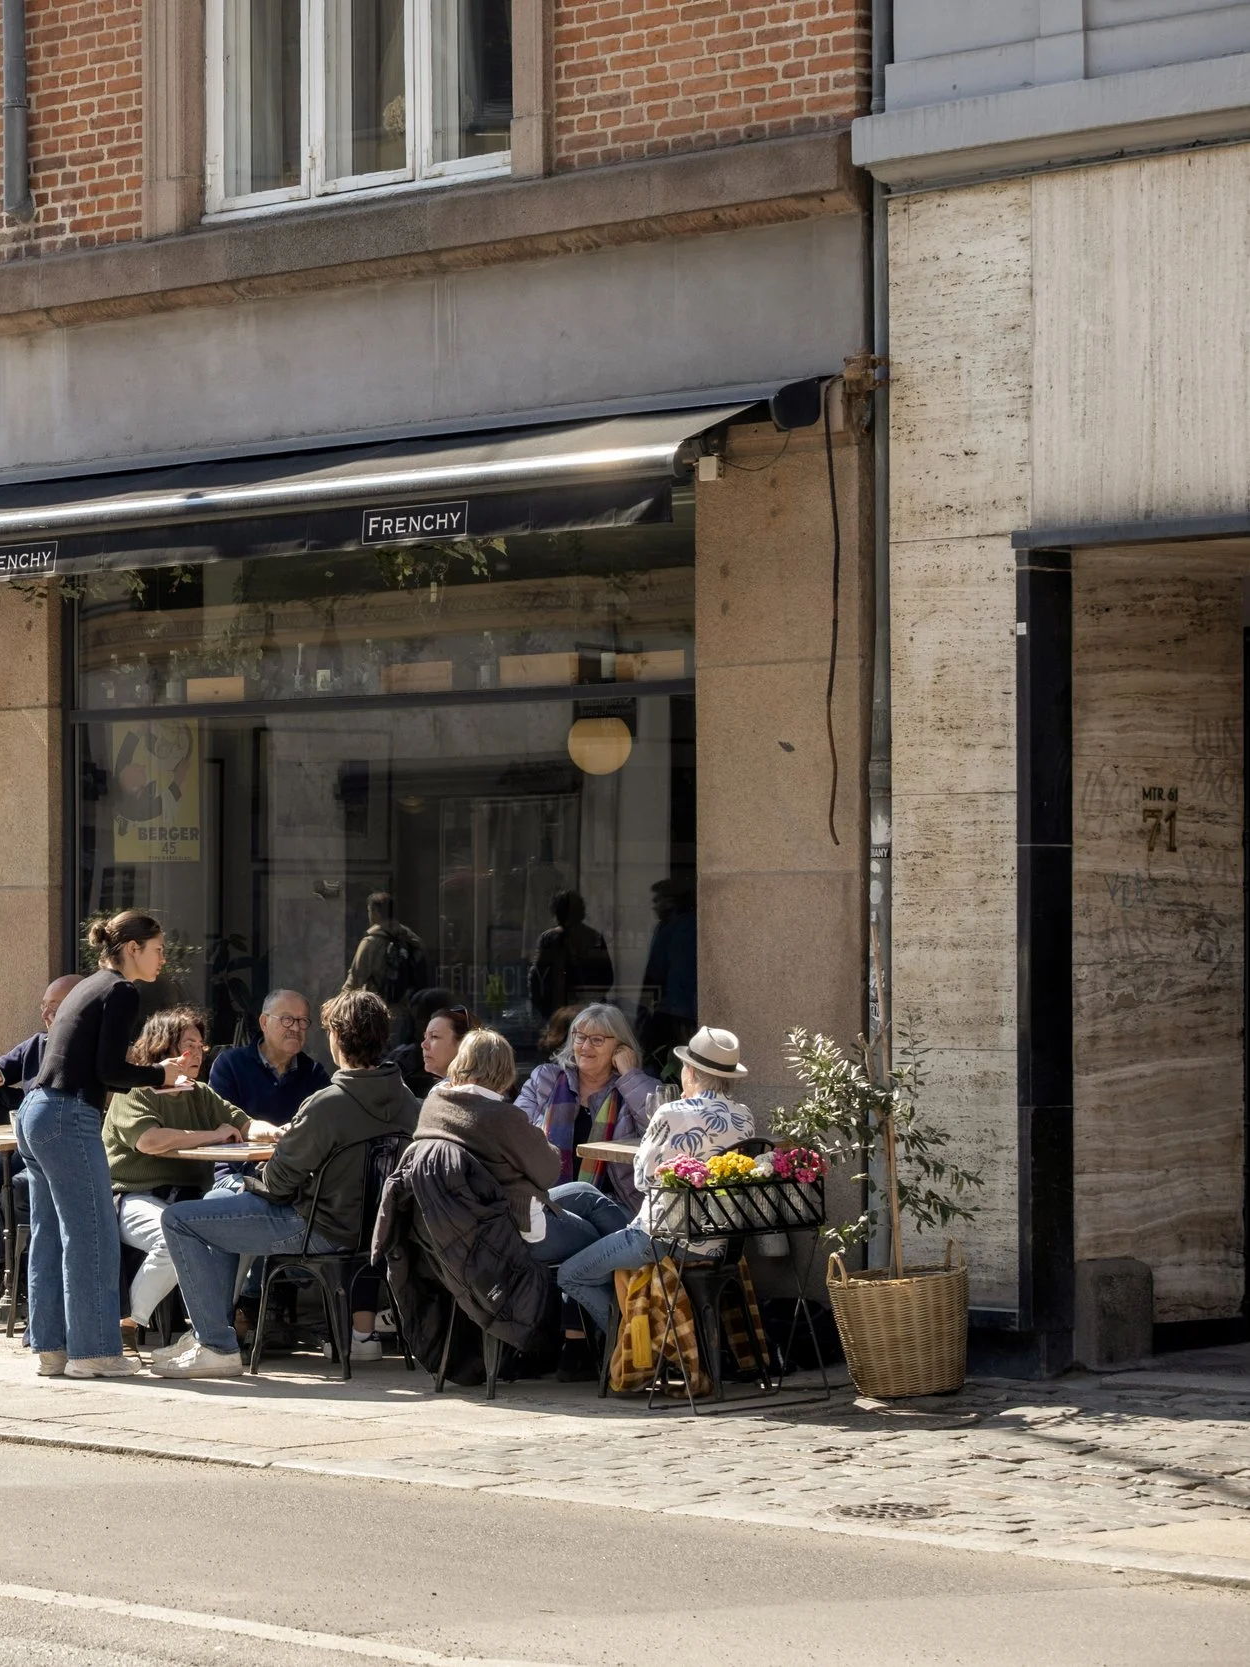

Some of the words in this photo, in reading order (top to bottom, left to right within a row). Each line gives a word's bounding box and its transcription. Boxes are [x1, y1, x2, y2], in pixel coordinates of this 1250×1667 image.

[369, 512, 461, 536] FRENCHY
[1142, 788, 1165, 801] MTR.
[138, 827, 199, 840] BERGER
[1142, 809, 1178, 852] 71
[161, 842, 176, 854] 45
